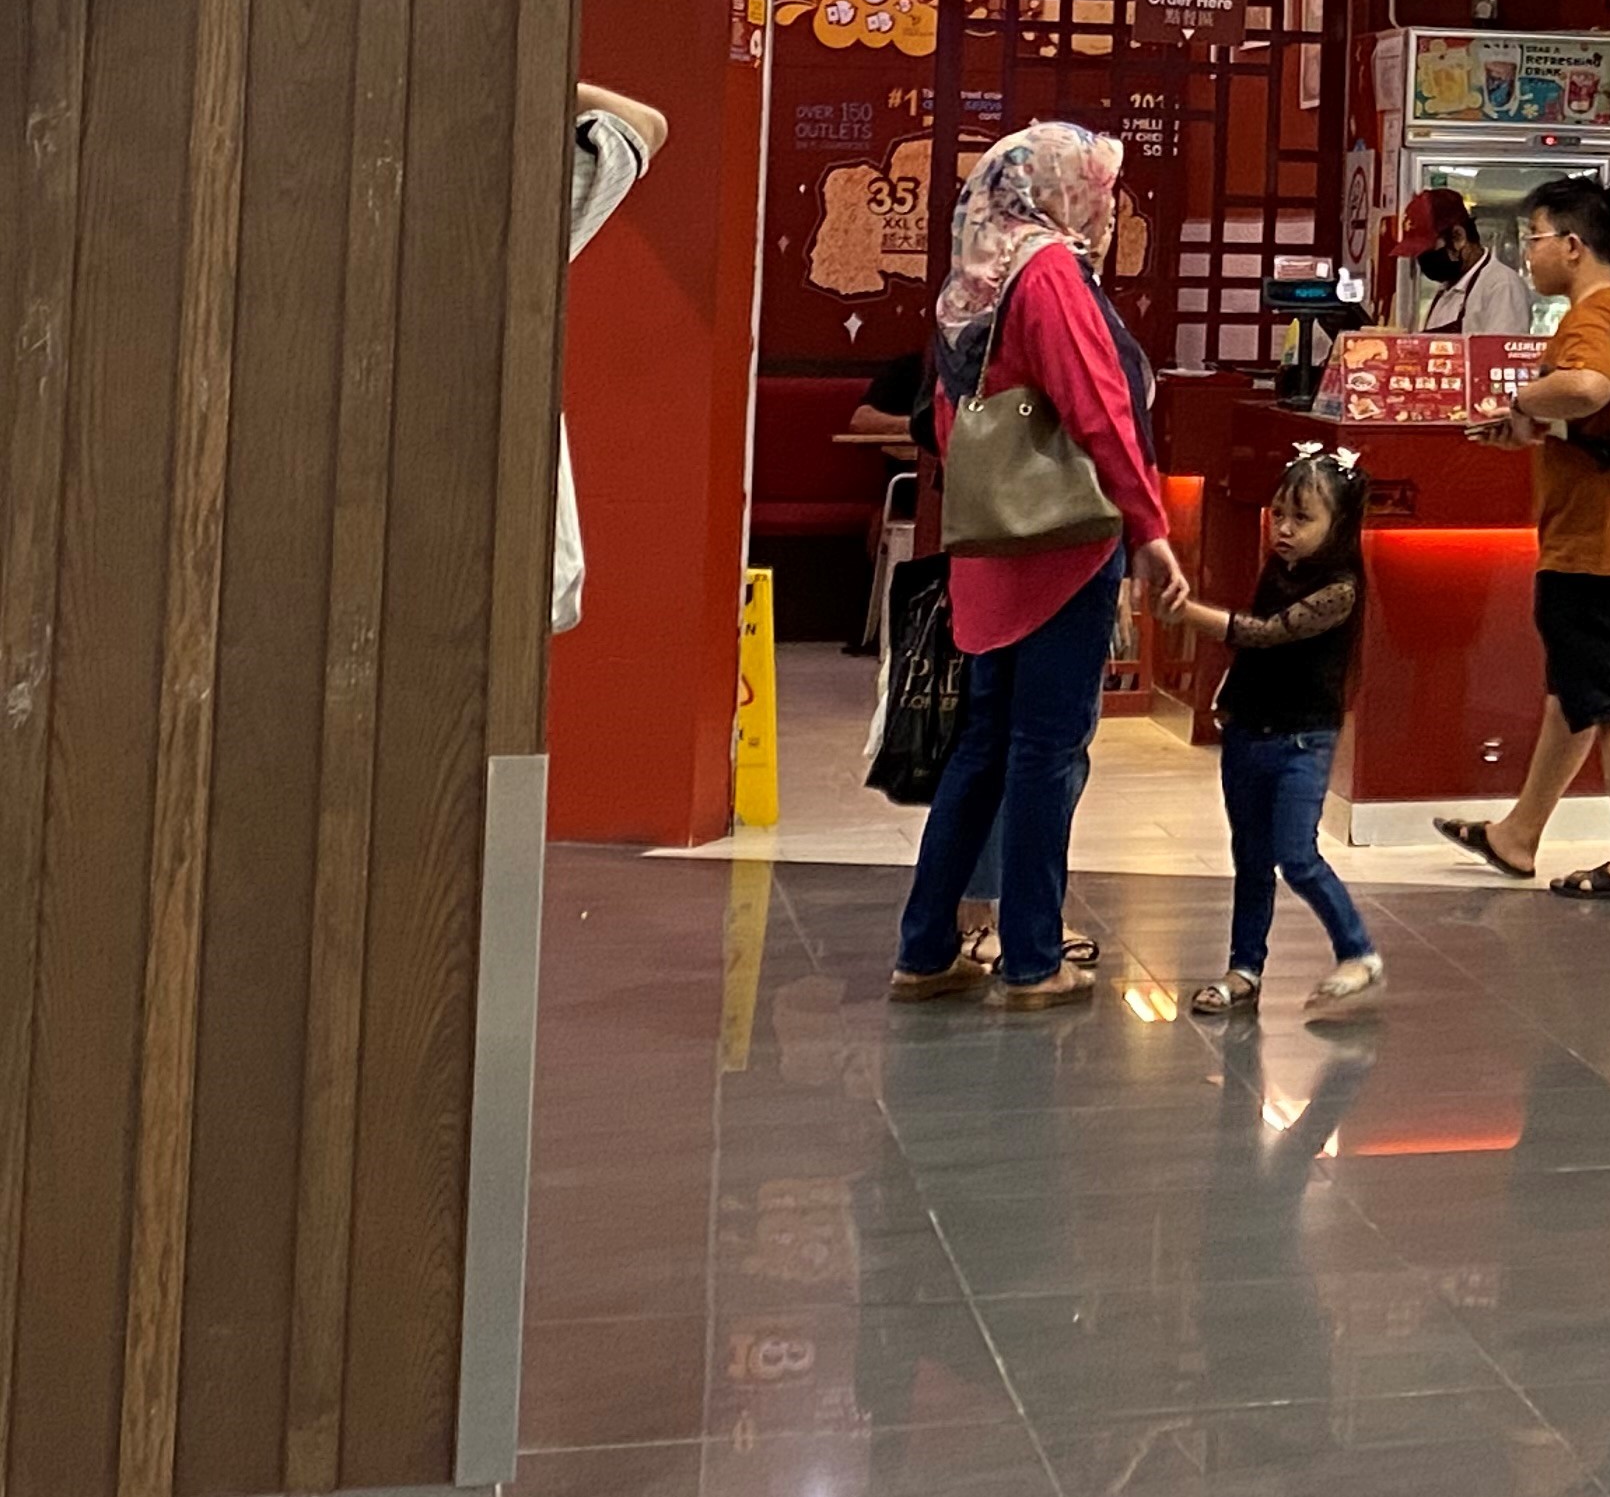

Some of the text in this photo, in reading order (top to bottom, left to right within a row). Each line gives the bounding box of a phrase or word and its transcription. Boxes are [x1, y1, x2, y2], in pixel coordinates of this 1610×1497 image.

[888, 88, 918, 116] #1
[795, 122, 873, 140] OUTLETS
[868, 176, 921, 215] 35
